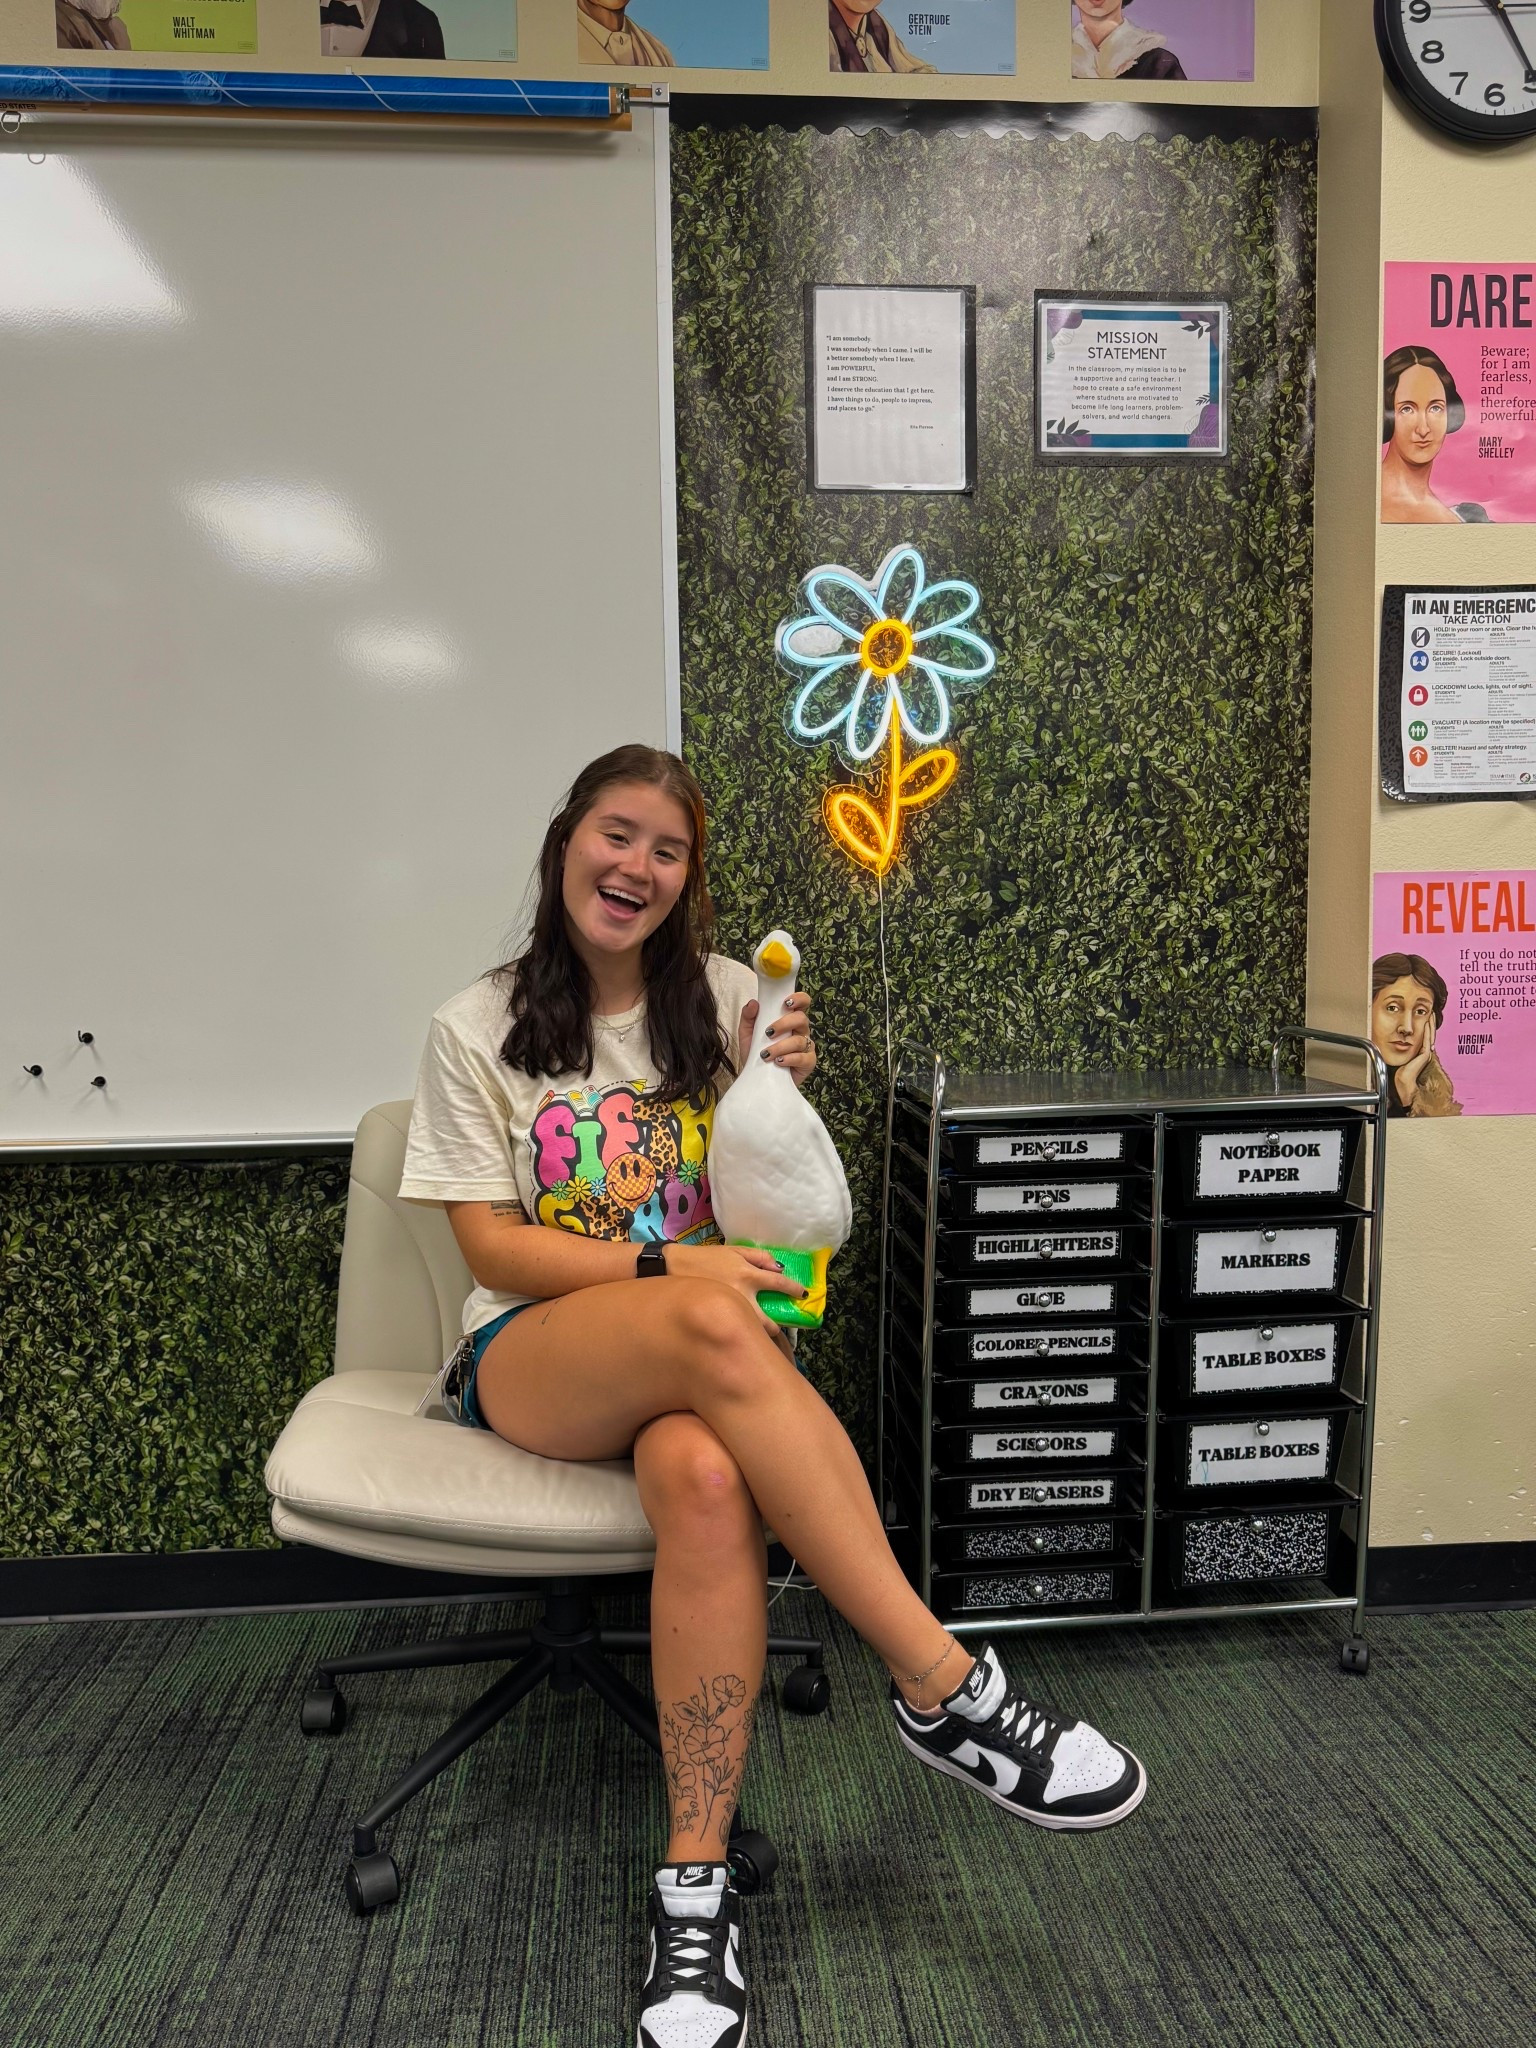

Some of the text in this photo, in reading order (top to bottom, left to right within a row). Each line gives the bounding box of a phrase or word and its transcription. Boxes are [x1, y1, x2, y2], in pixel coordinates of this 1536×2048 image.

[1409, 0, 1431, 23] 9
[172, 17, 195, 27] WALT
[908, 14, 950, 25] GERTRUDE
[173, 28, 215, 39] WHITMAN
[908, 25, 932, 35] STEIN
[1421, 40, 1444, 64] 8
[1449, 72, 1469, 95] 7
[1484, 83, 1505, 107] 6
[1430, 273, 1533, 328] DARE
[1097, 332, 1158, 344] MISSION
[842, 346, 870, 354] somebody
[1088, 347, 1167, 359] STATEMENT
[1481, 346, 1530, 359] Beware;
[1481, 358, 1530, 369] for I am
[1481, 371, 1532, 384] fearless,
[1481, 383, 1503, 395] and
[1155, 404, 1184, 412] problem-
[1481, 396, 1536, 408] therefore
[1480, 410, 1536, 423] powerful.
[1479, 437, 1503, 448] MARY
[1478, 448, 1515, 458] SHELLEY
[1412, 598, 1536, 614] IN AN EMERGENC
[1442, 615, 1511, 624] TAKE ACTION
[1403, 881, 1535, 934] REVEAL
[1460, 949, 1470, 960] If
[1473, 951, 1495, 962] you
[1499, 948, 1514, 959] do
[1460, 960, 1479, 972] tell
[1484, 960, 1503, 971] the
[1460, 973, 1494, 984] about
[1460, 988, 1481, 999] you
[1485, 986, 1527, 996] cannot
[1460, 998, 1469, 1008] it
[1472, 997, 1506, 1008] about
[1459, 1010, 1502, 1023] people.
[1458, 1034, 1493, 1045] VIRGINIA
[1457, 1044, 1485, 1055] WOOLF
[1219, 1143, 1321, 1160] NOTEBOOK
[1238, 1167, 1300, 1183] PAPER
[1221, 1253, 1311, 1269] MARKERS
[1017, 1291, 1065, 1306] GLE
[1048, 1336, 1111, 1348] PENCILS
[1202, 1348, 1326, 1369] TABLE BOXES
[996, 1437, 1087, 1451] SCISORS
[1198, 1443, 1320, 1462] TABLE BOXES
[977, 1488, 1016, 1502] DRY
[968, 1667, 981, 1690] NIKE
[685, 1866, 703, 1876] NIKE
